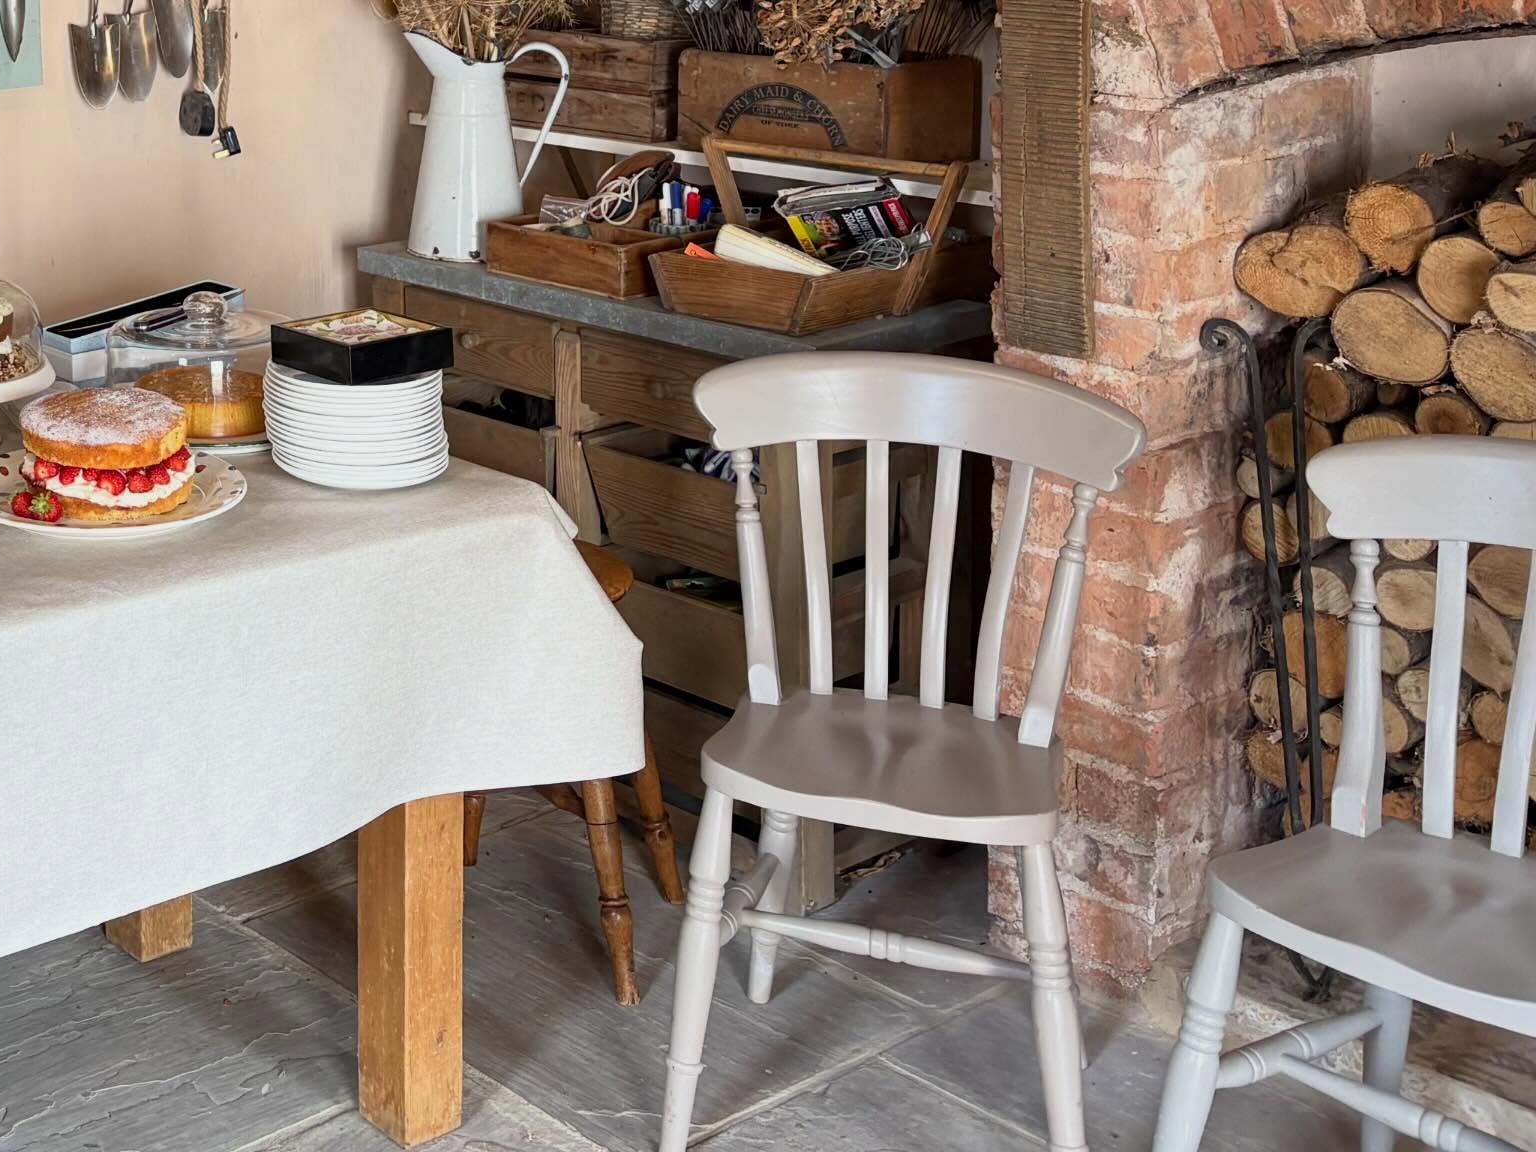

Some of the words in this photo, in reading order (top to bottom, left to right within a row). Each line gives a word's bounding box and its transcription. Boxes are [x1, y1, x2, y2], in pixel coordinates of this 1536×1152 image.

[718, 94, 751, 133] DAIRY
[753, 86, 790, 102] MAID
[792, 91, 804, 104] &
[806, 98, 842, 148] CHURN
